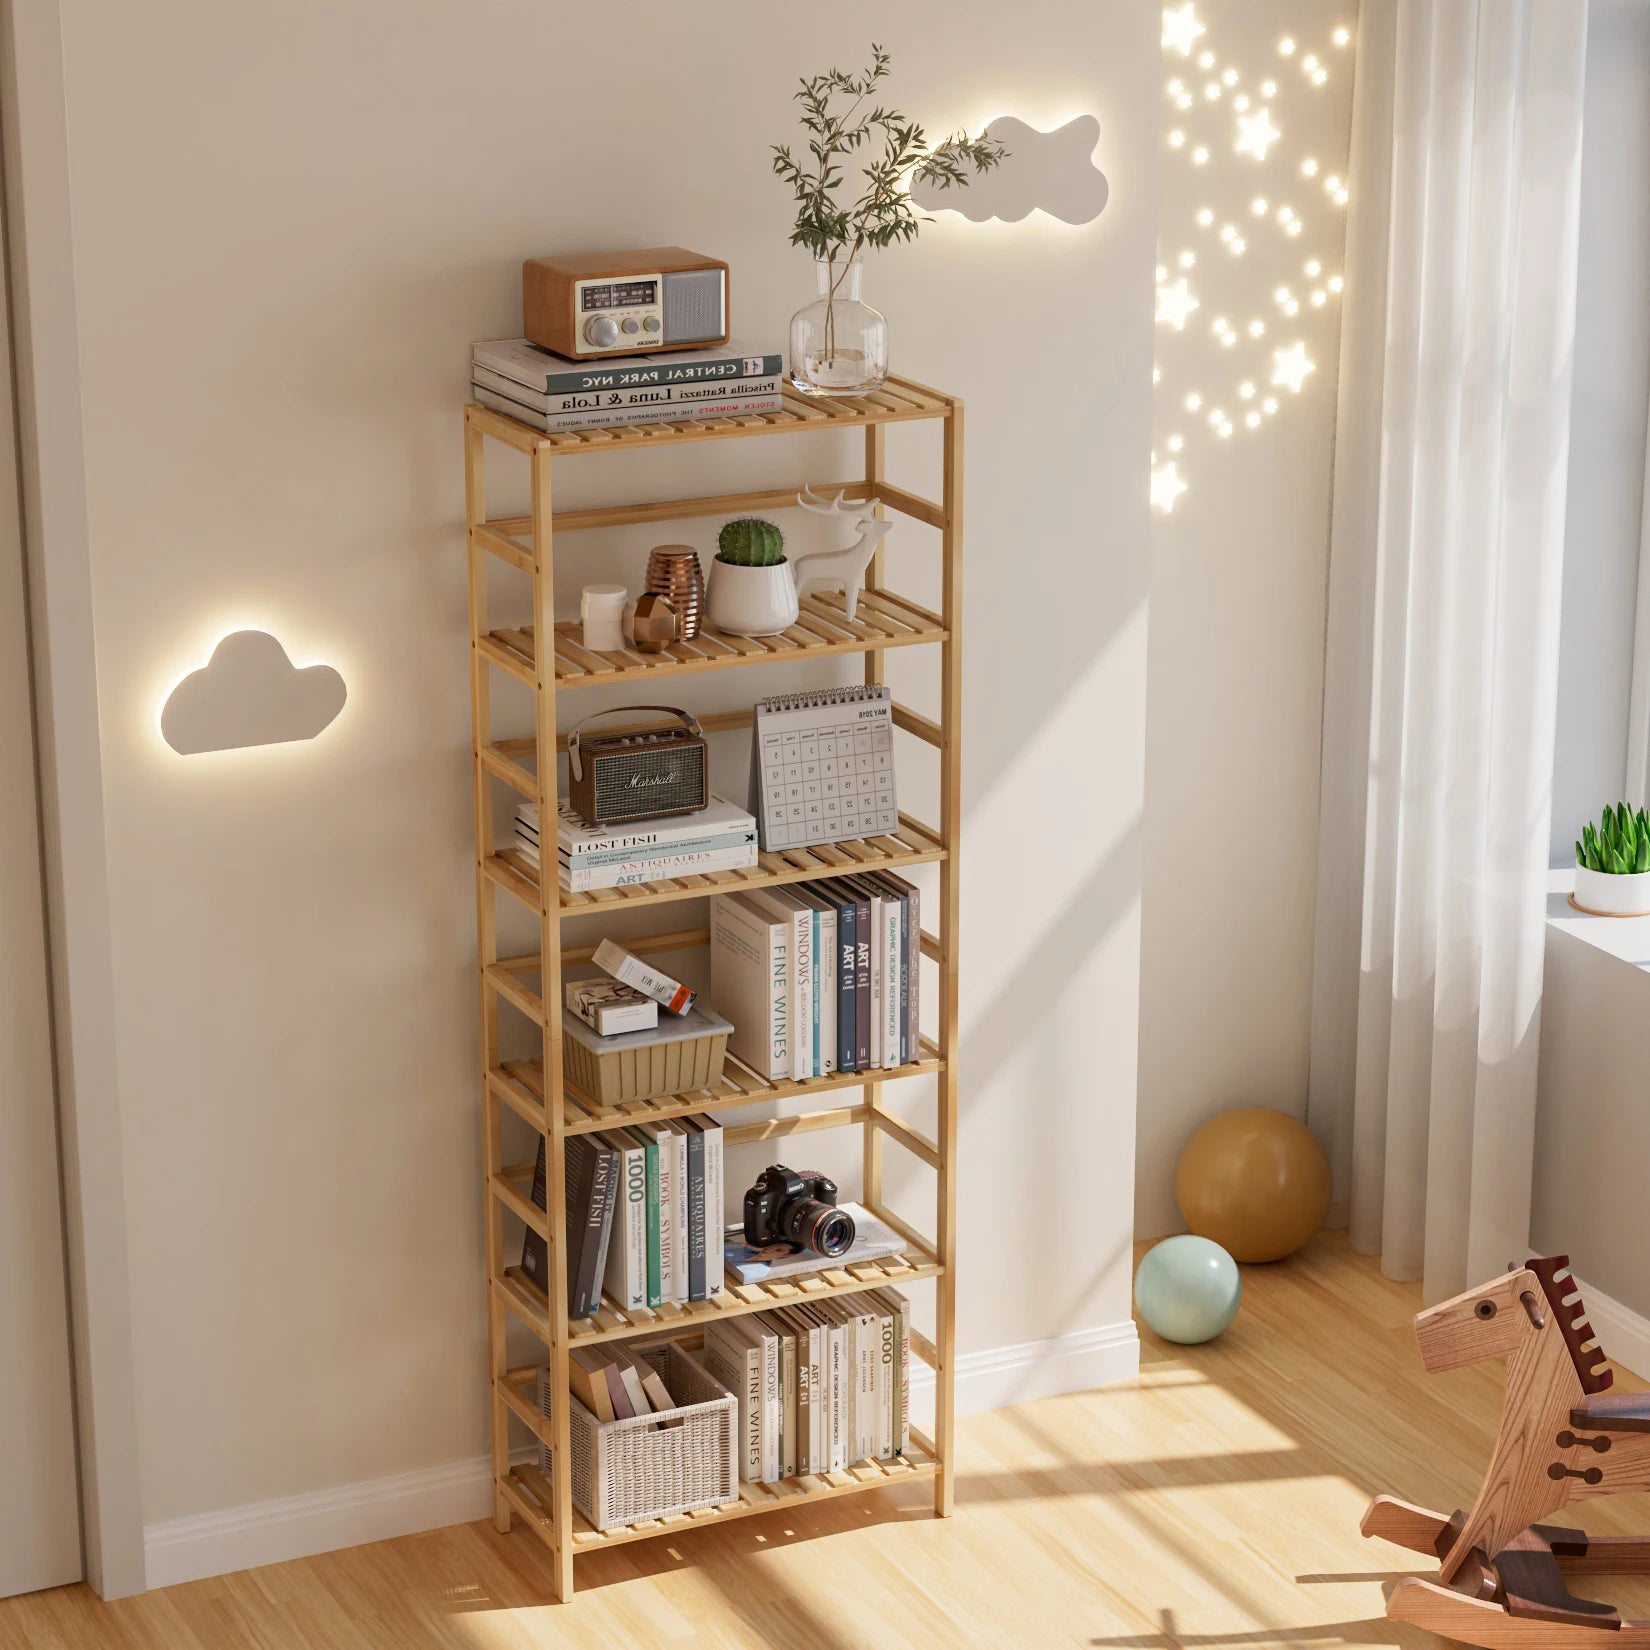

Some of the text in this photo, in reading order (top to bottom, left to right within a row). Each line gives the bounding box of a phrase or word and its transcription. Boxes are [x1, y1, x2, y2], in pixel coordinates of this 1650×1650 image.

[624, 770, 678, 790] Marshall
[577, 834, 658, 854] LOST FISH
[619, 852, 711, 870] ANTIQUAIRES
[616, 873, 645, 886] ART
[774, 945, 786, 988] FINE
[798, 915, 810, 986] WINDOWS
[843, 944, 855, 970] ART
[858, 942, 869, 969] ART
[640, 975, 665, 993] PIE MIX
[774, 995, 787, 1059] WINES
[594, 1153, 611, 1193] LOST
[606, 1159, 619, 1201] MAKING
[628, 1154, 644, 1203] 1000
[660, 1172, 670, 1207] BOOK
[589, 1195, 605, 1228] FISH
[604, 1203, 614, 1214] IT
[694, 1176, 704, 1259] ANTIQUAIRES
[881, 1321, 893, 1364] 1000
[767, 1341, 776, 1402] WINDOWS
[800, 1366, 808, 1388] ART
[811, 1364, 819, 1387] ART
[749, 1367, 759, 1466] FINE WINES
